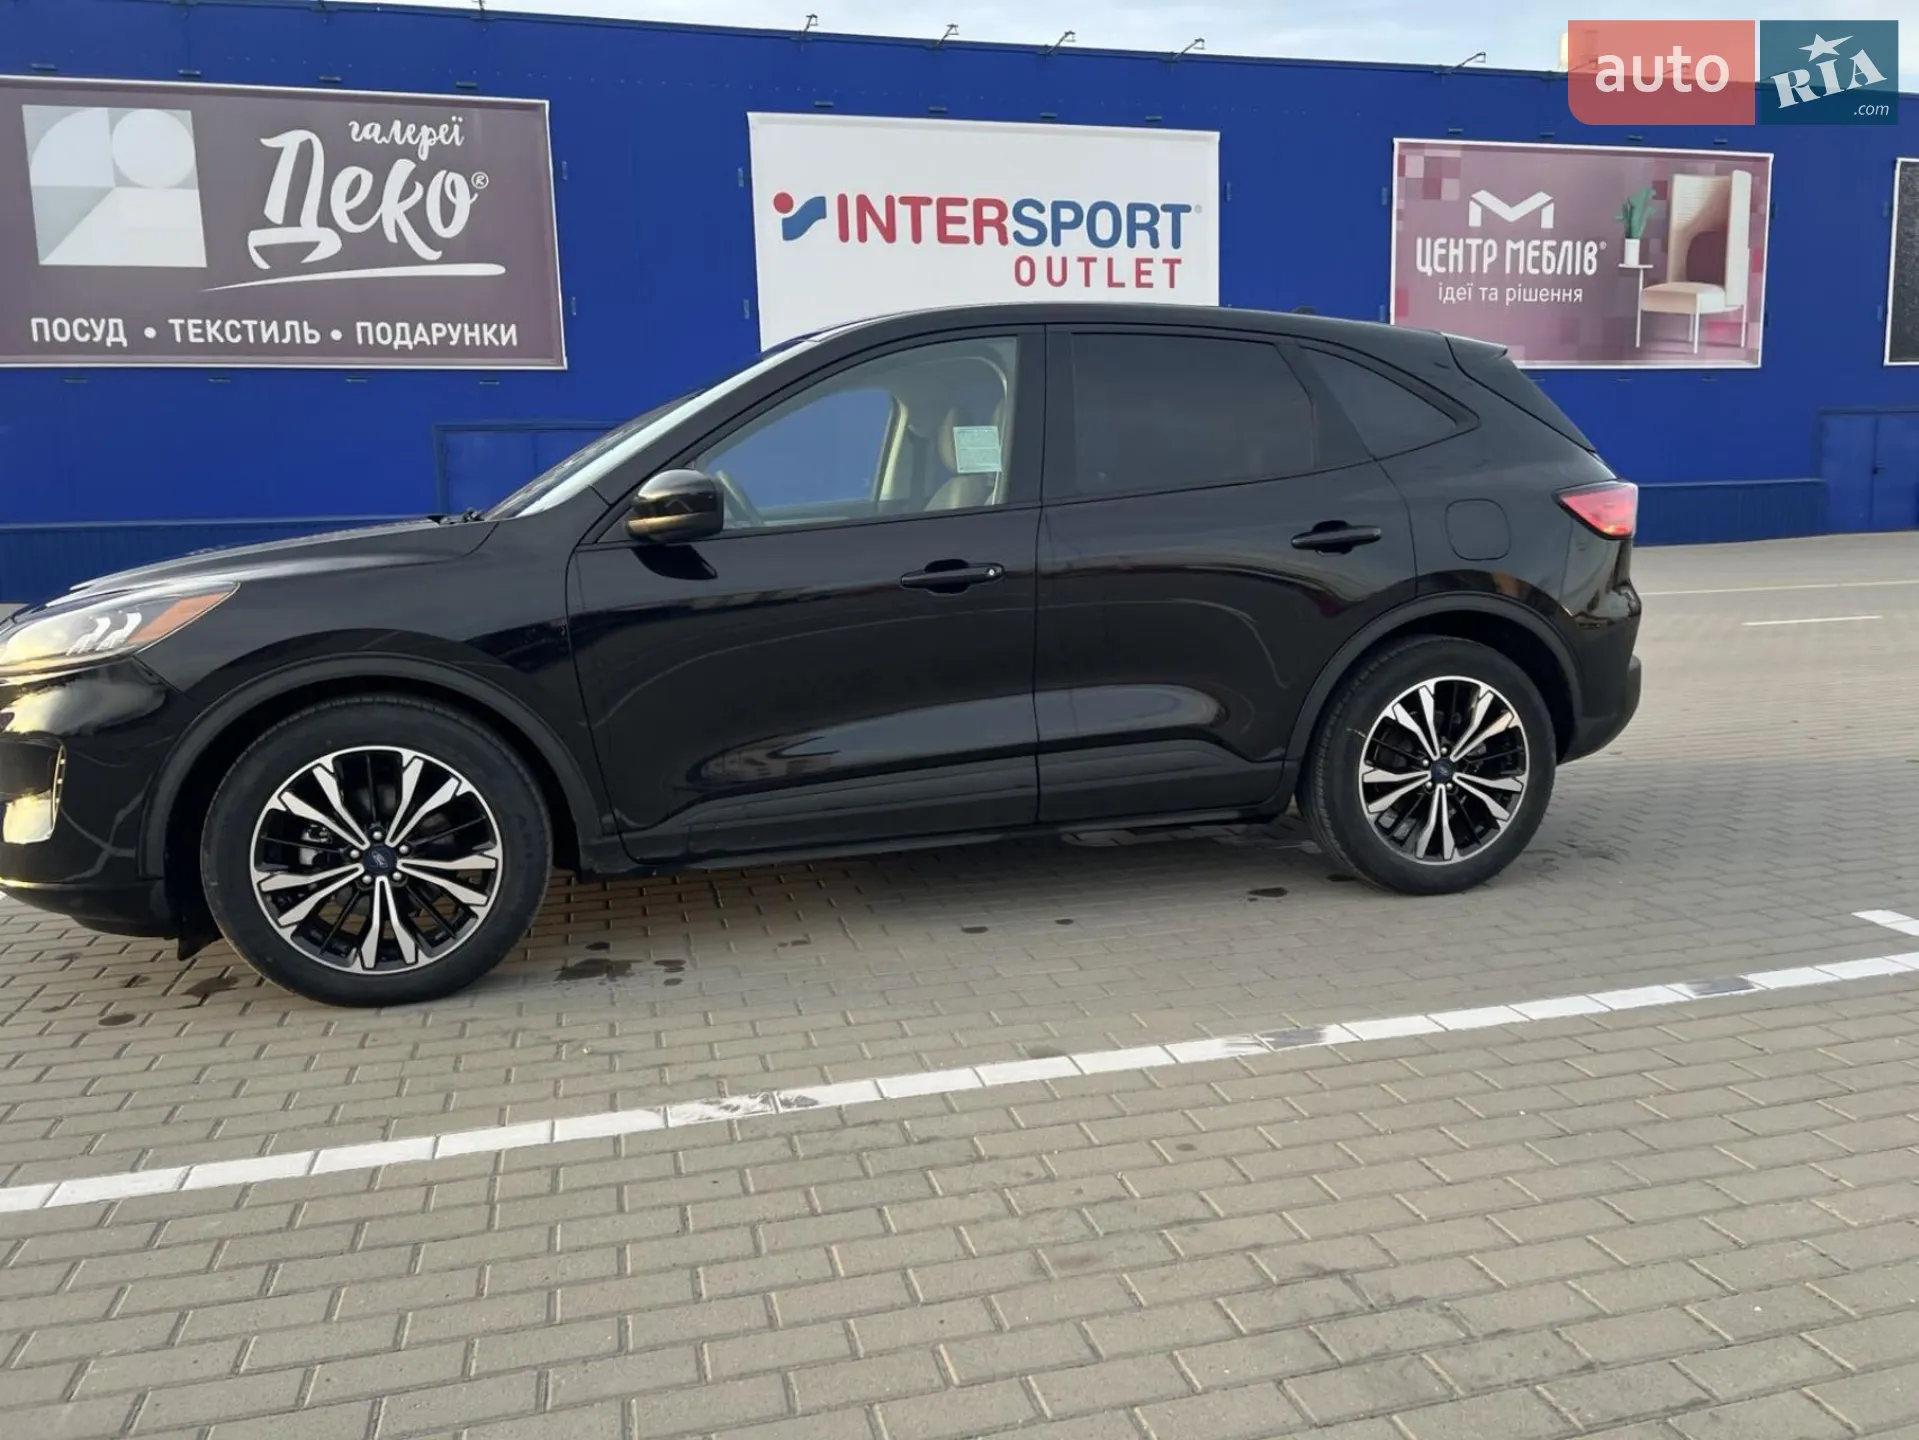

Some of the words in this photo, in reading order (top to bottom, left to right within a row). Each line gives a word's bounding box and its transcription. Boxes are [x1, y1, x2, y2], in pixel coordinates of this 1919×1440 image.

[348, 116, 465, 161] галереї
[836, 193, 1193, 250] INTERSPORT
[1013, 254, 1183, 289] OUTLET
[1416, 237, 1498, 277] ЦЕНТР
[1438, 282, 1474, 304] ідеї
[1478, 286, 1499, 302] та
[1505, 283, 1584, 306] рішення
[30, 316, 128, 347] ПОСУД
[168, 318, 321, 345] ТЕКСТИЛЬ
[356, 321, 519, 349] ПОДАРУНКИ
